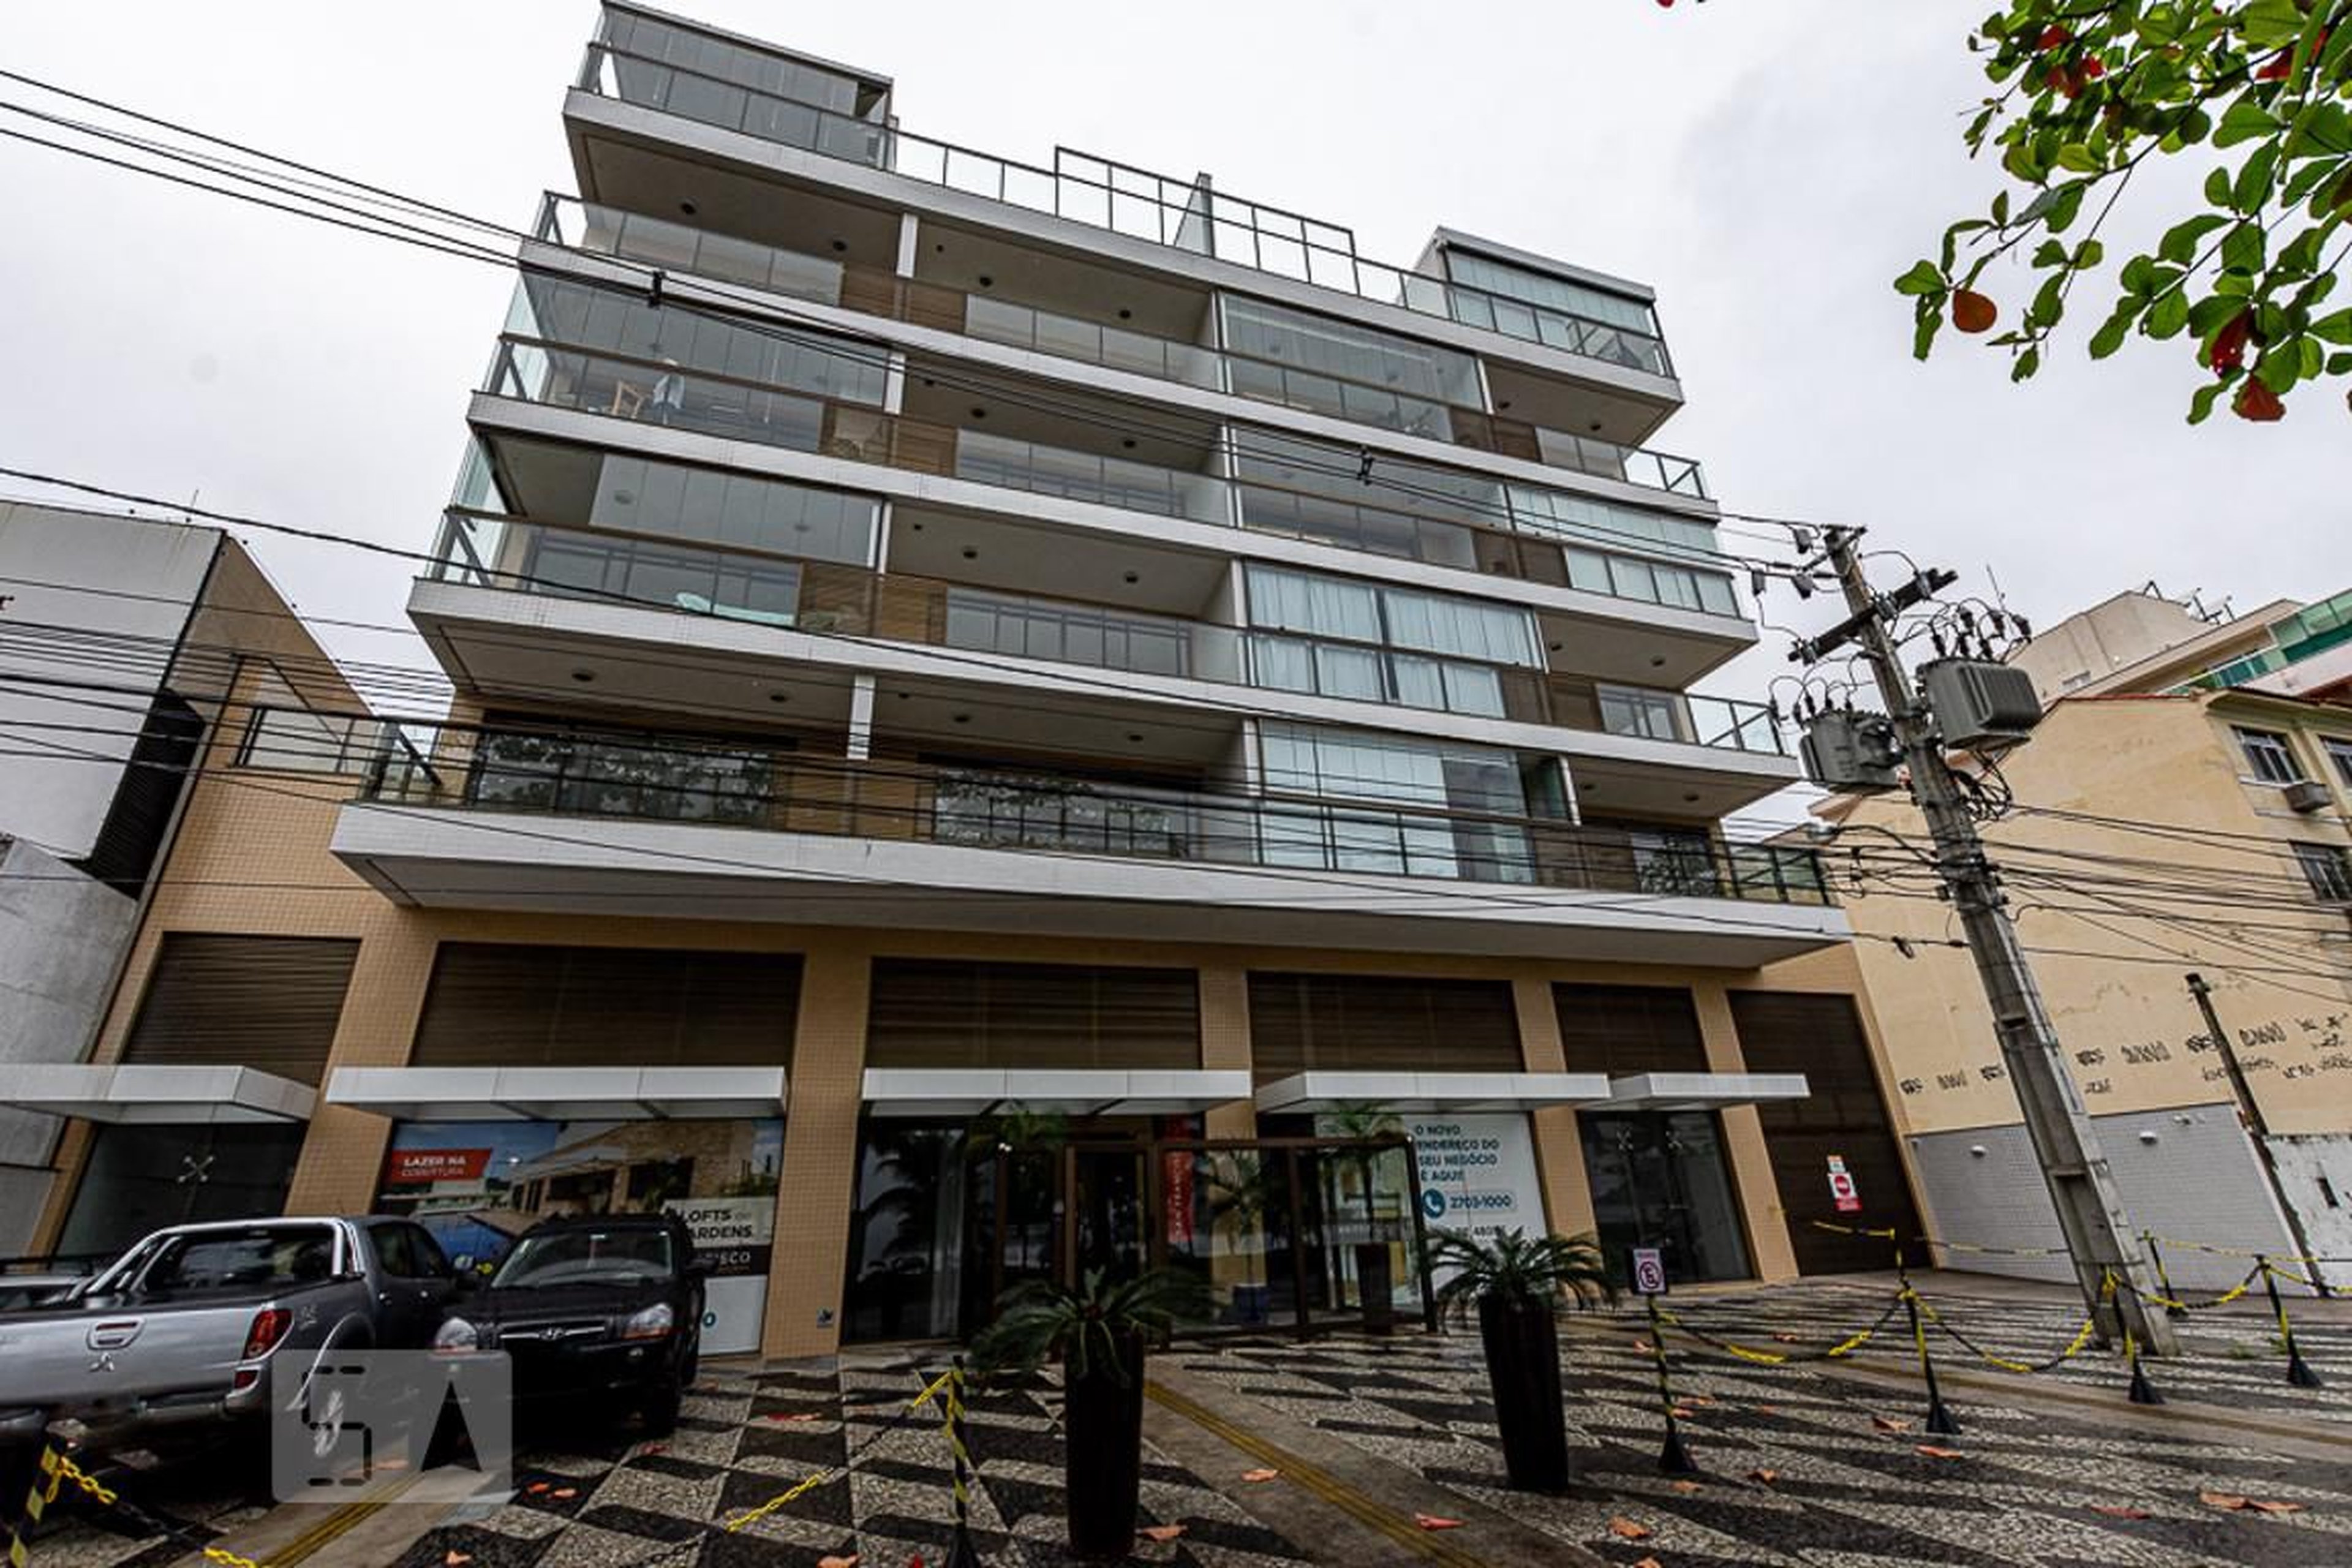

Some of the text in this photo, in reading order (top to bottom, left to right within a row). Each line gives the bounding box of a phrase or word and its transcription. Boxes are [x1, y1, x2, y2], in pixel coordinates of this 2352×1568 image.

[1416, 1125, 1460, 1135] O NOVO
[1481, 1139, 1499, 1150] DO
[404, 1156, 444, 1166] LAZER
